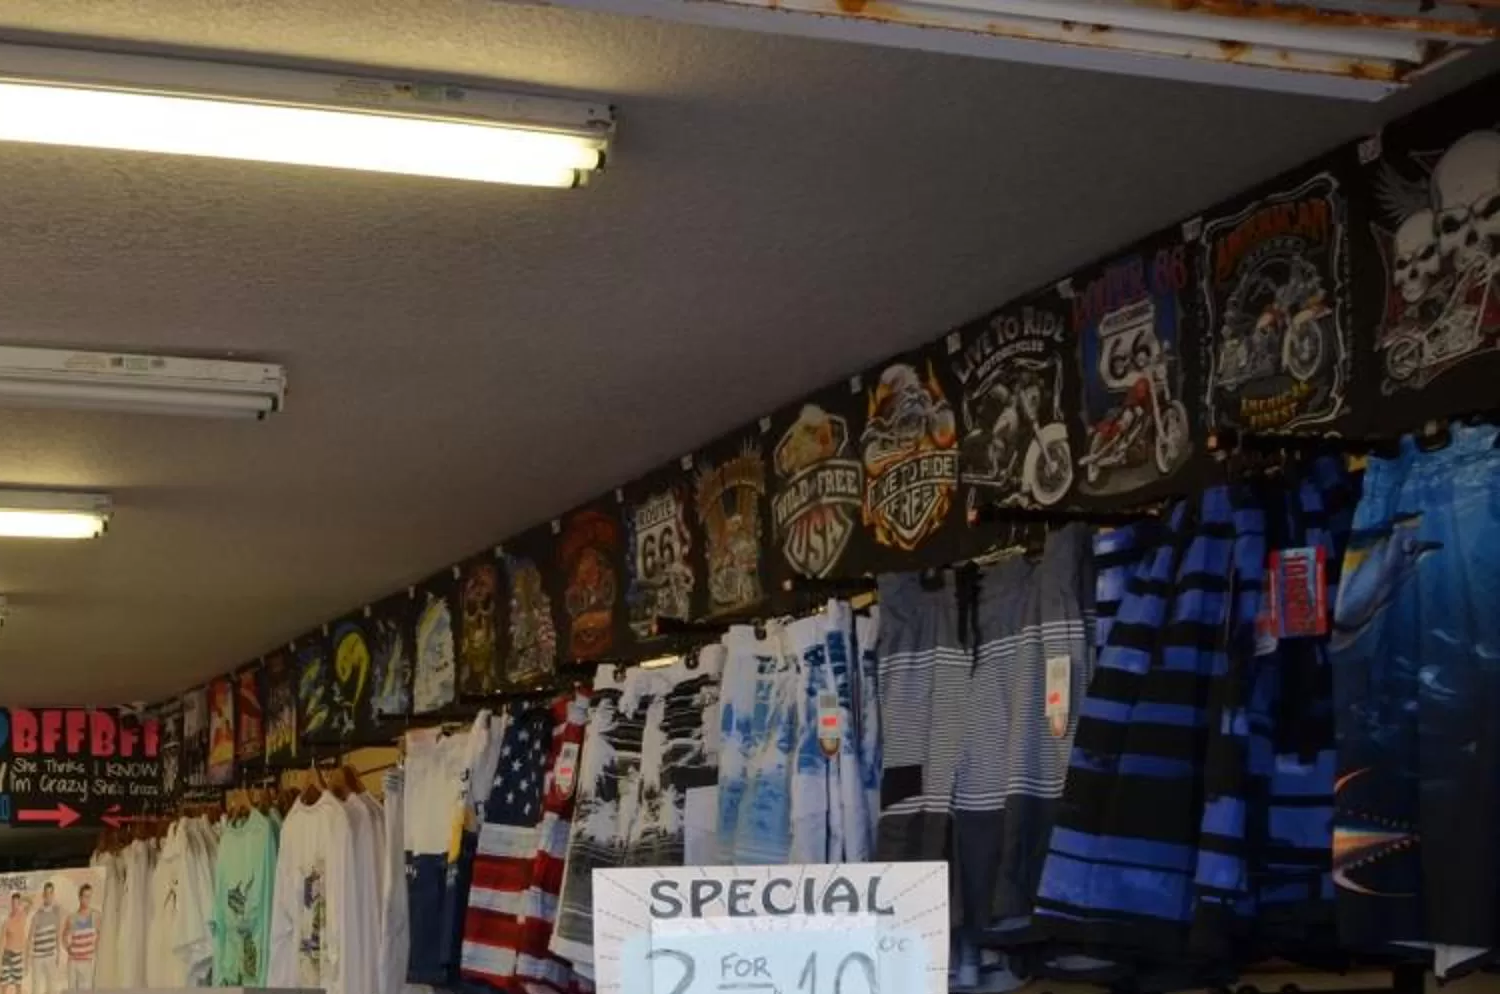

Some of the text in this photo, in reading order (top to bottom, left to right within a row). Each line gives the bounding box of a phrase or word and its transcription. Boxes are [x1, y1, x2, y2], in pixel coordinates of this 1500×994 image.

[1108, 329, 1152, 380] 66
[816, 468, 860, 496] FREE
[642, 526, 676, 579] 66
[791, 511, 846, 573] USA
[10, 708, 87, 755] BFF
[11, 757, 38, 774] She
[104, 761, 159, 779] KNOW
[39, 774, 89, 804] Crazy
[649, 875, 895, 919] SPECIAL
[720, 951, 772, 979] FOR
